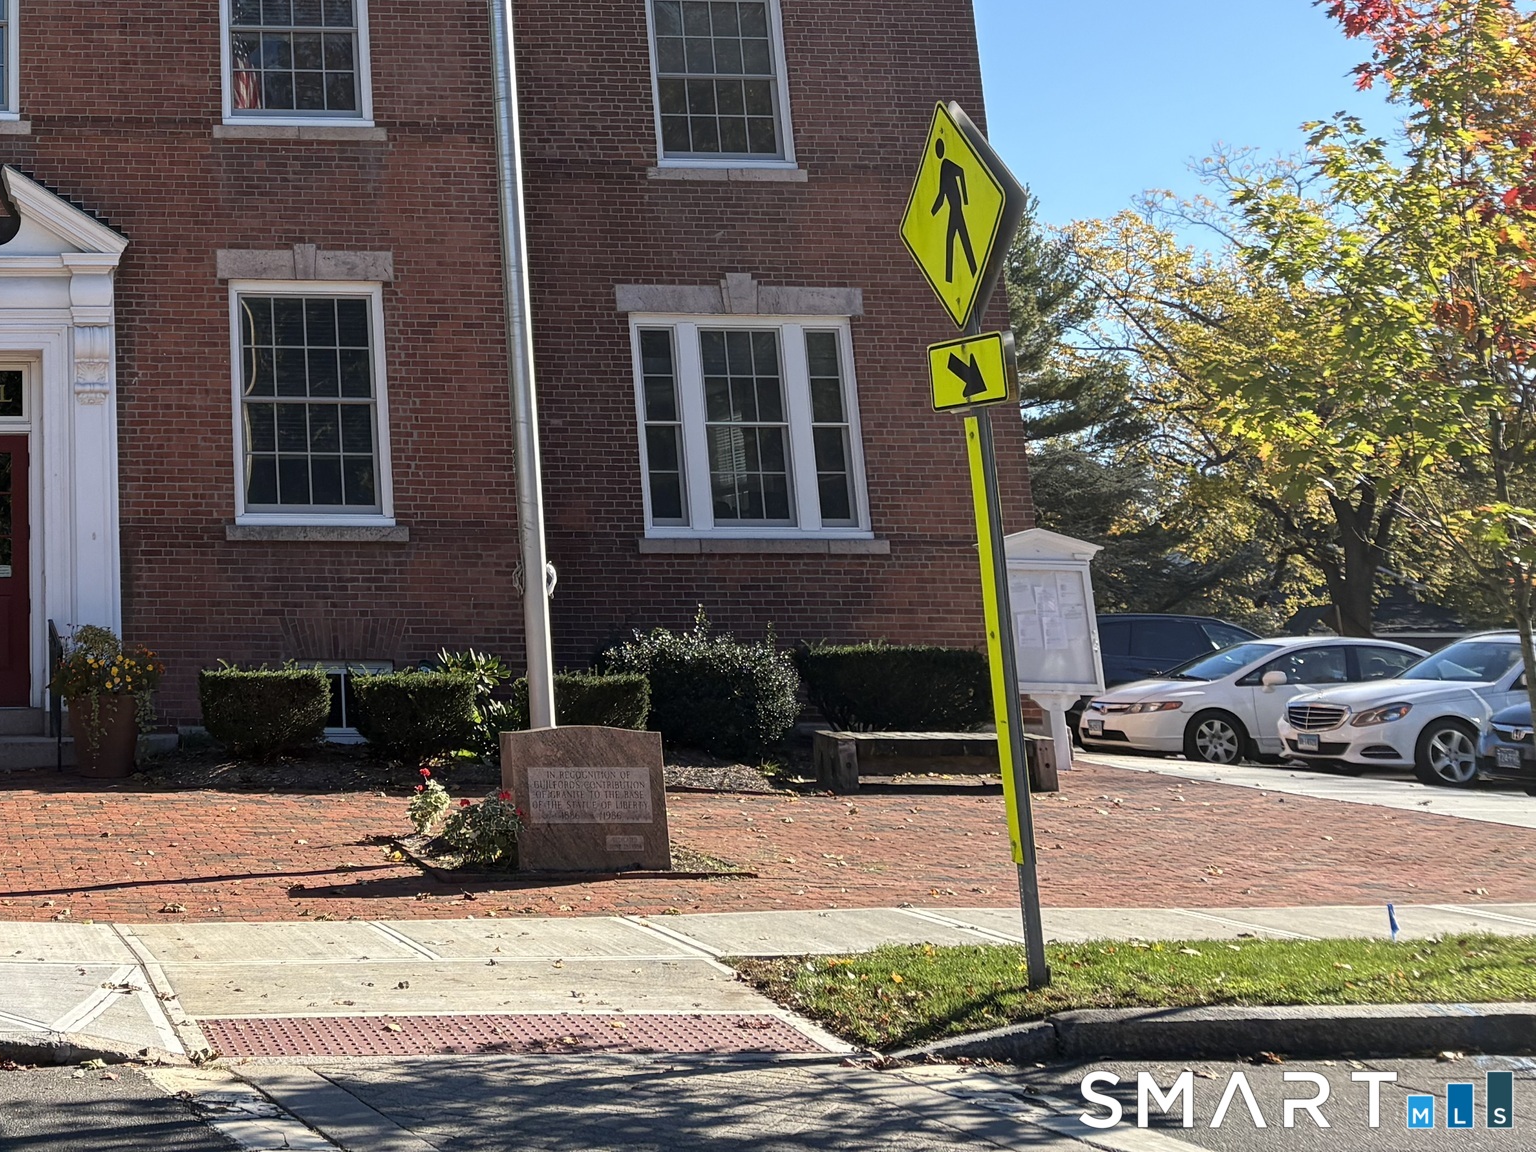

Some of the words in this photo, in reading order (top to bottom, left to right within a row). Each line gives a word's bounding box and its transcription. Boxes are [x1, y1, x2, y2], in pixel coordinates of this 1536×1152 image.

[546, 770, 556, 779] IN
[559, 770, 616, 780] RECOGNITION
[619, 770, 631, 780] OF
[583, 780, 645, 789] CONTRIBUTION
[535, 790, 546, 799] OF
[548, 790, 585, 799] GRANITE
[590, 790, 601, 799] TO
[604, 790, 620, 799] THE
[624, 790, 645, 799] BASE
[531, 800, 543, 809] OF
[547, 800, 562, 809] THE
[566, 800, 597, 809] STATUE
[600, 800, 612, 809] OF
[615, 800, 648, 809] LIBERTY
[602, 811, 623, 820] 1986
